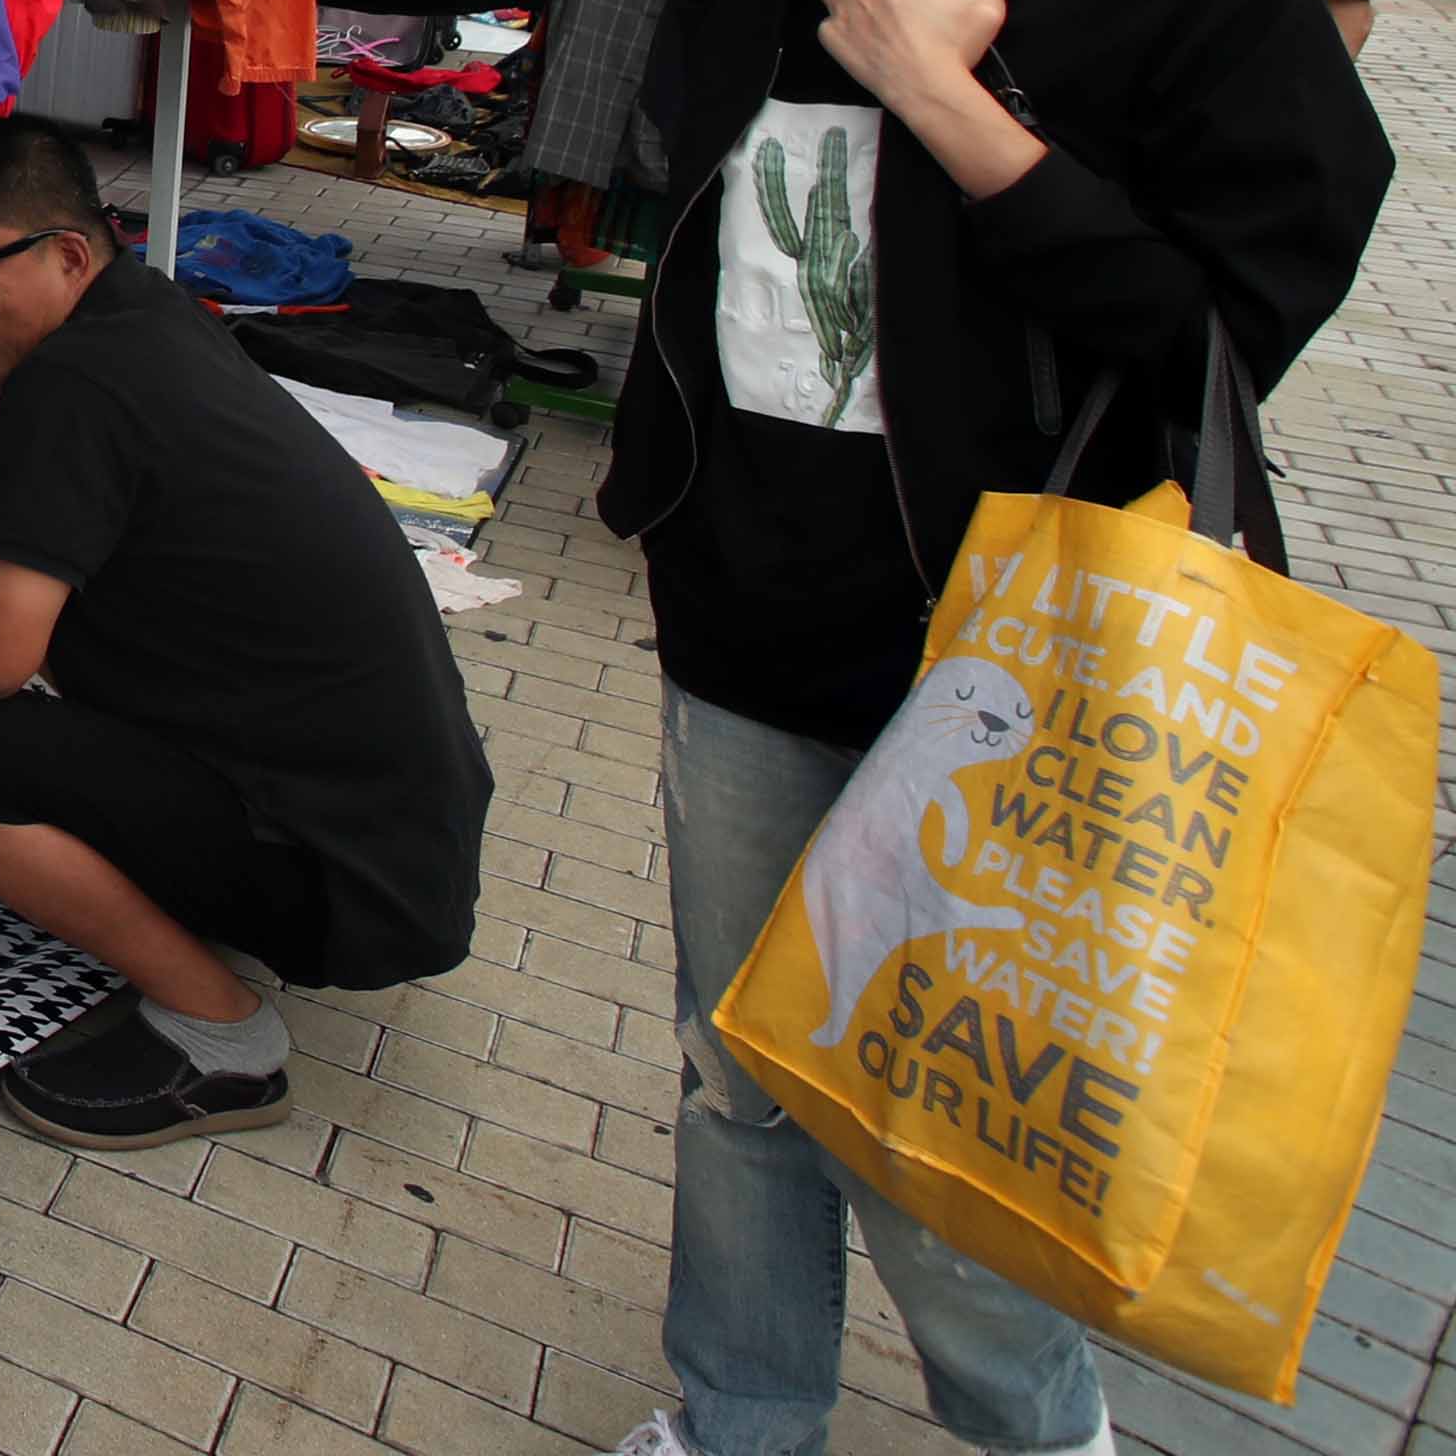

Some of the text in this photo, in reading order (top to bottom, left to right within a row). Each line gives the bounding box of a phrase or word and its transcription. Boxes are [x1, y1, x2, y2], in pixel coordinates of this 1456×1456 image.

[1031, 565, 1298, 712] LITTLE
[1042, 689, 1249, 816] I LOVE
[1117, 665, 1260, 757] AND
[991, 783, 1215, 928] WATER.
[1025, 745, 1232, 870] CLEAN
[971, 840, 1199, 973] PLEASE
[1021, 919, 1177, 1023] SAVE
[889, 962, 1140, 1159] SAVE
[944, 930, 1165, 1075] WATER!
[857, 1031, 1112, 1217] OUR LIFE!
